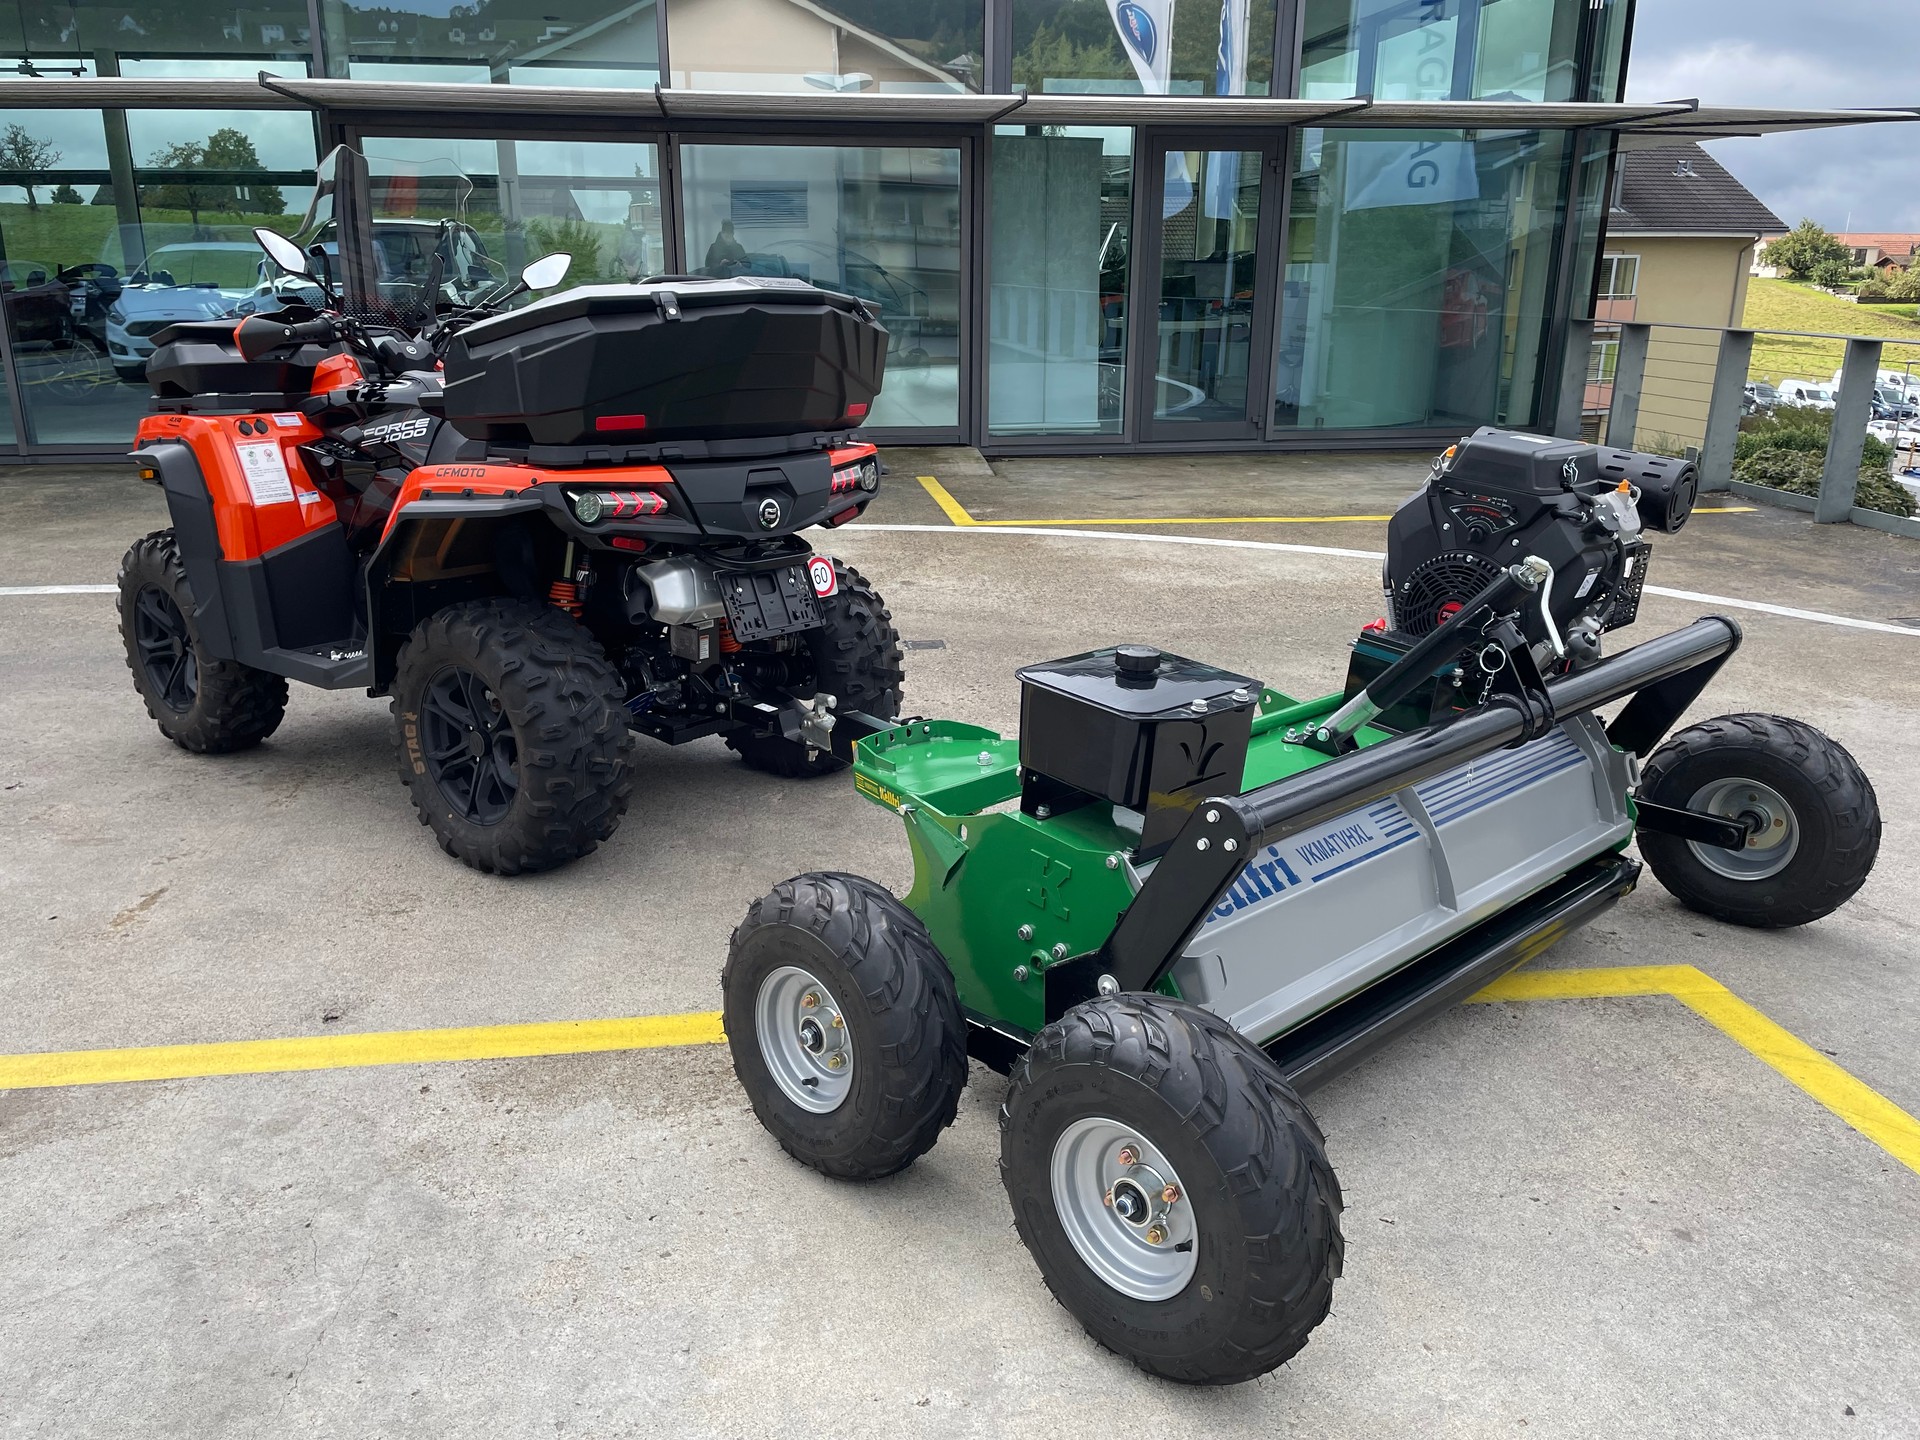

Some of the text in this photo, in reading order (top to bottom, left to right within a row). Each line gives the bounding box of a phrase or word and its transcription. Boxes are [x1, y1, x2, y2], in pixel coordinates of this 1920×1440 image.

[1415, 0, 1448, 99] RAG
[362, 417, 431, 437] FORCE
[383, 428, 427, 444] 1000
[436, 467, 486, 478] CFMOTO
[813, 566, 828, 584] 60
[1206, 823, 1375, 923] ellfri VKMATVHXL
[1026, 848, 1072, 921] K
